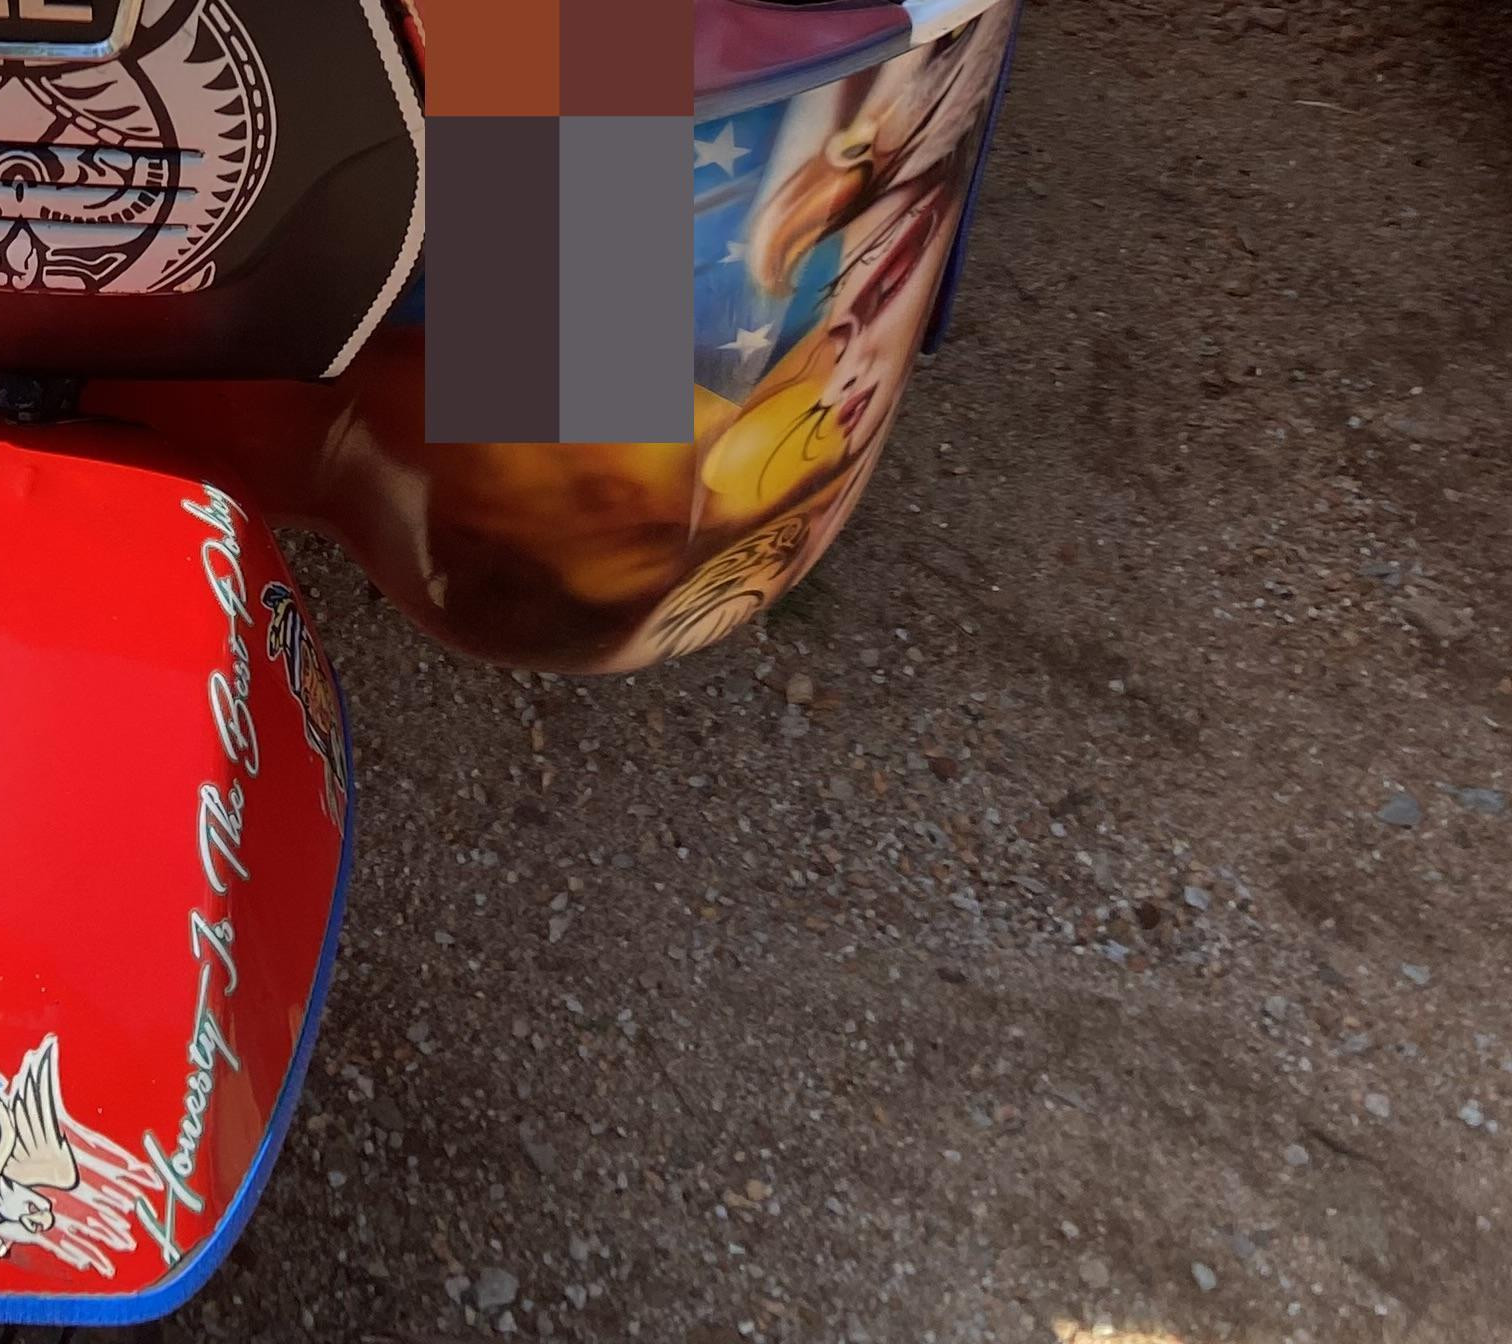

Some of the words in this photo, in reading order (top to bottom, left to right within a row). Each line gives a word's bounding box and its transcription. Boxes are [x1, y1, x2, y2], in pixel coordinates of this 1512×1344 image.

[208, 615, 259, 779] Best
[198, 778, 249, 895] The
[190, 908, 238, 997] Is
[135, 962, 240, 1265] Honesty
